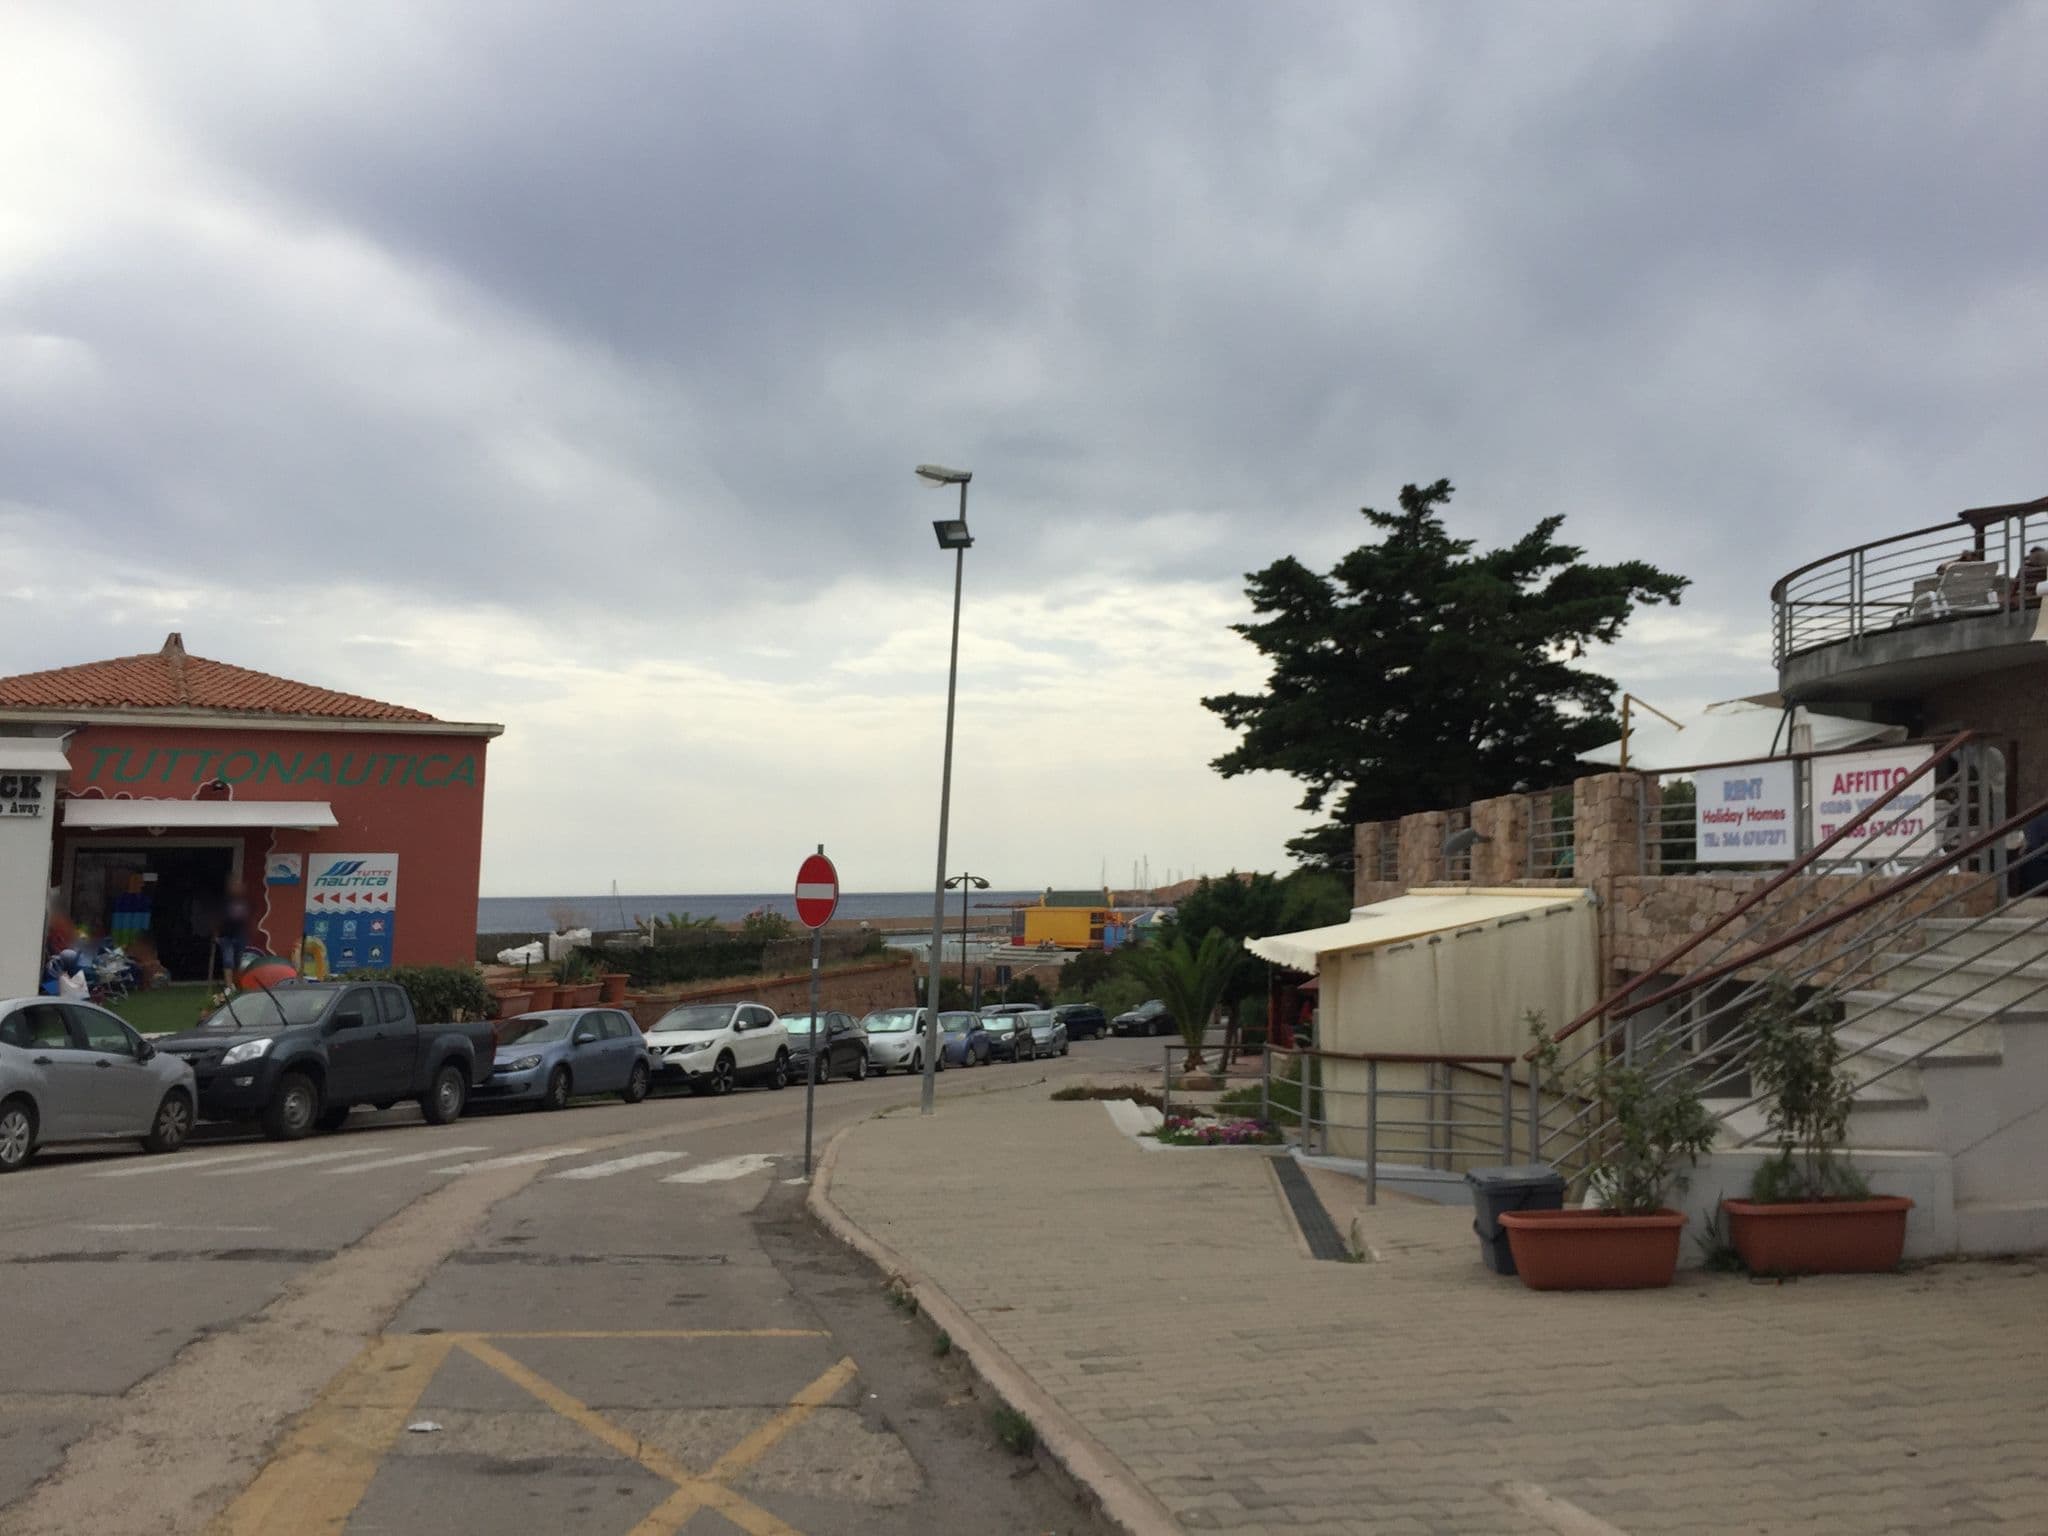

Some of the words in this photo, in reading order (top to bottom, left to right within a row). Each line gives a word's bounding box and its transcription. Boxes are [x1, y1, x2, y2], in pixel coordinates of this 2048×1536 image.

[87, 746, 476, 788] TUTTONAUTICA
[1723, 777, 1763, 801] RENT
[1832, 767, 1909, 795] AFFITTO
[10, 801, 40, 817] Away
[1702, 807, 1744, 827] Holiday
[1747, 806, 1786, 822] Homes
